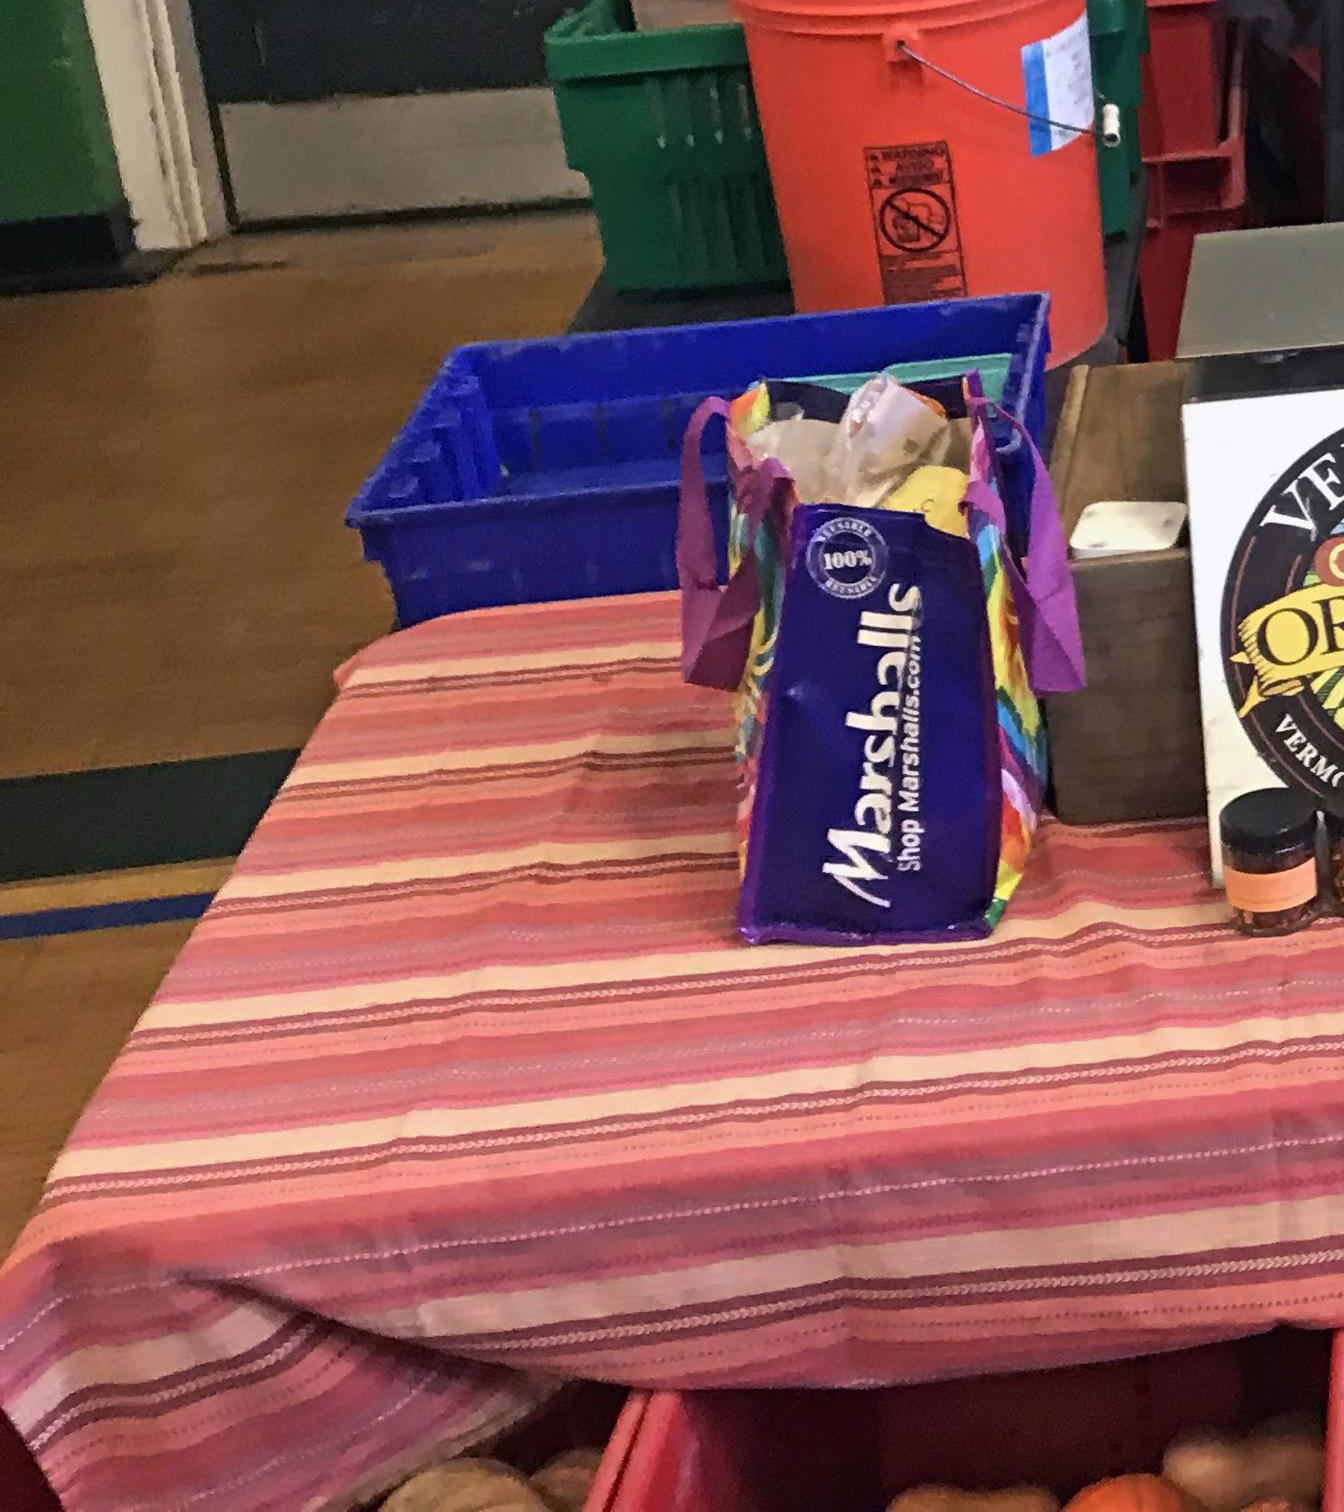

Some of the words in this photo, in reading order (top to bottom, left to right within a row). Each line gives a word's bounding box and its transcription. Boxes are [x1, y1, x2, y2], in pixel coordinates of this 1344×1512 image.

[824, 550, 873, 570] 100%
[822, 583, 922, 909] Marshalls
[897, 635, 922, 813] Marshalls.com
[897, 819, 925, 872] Shop
